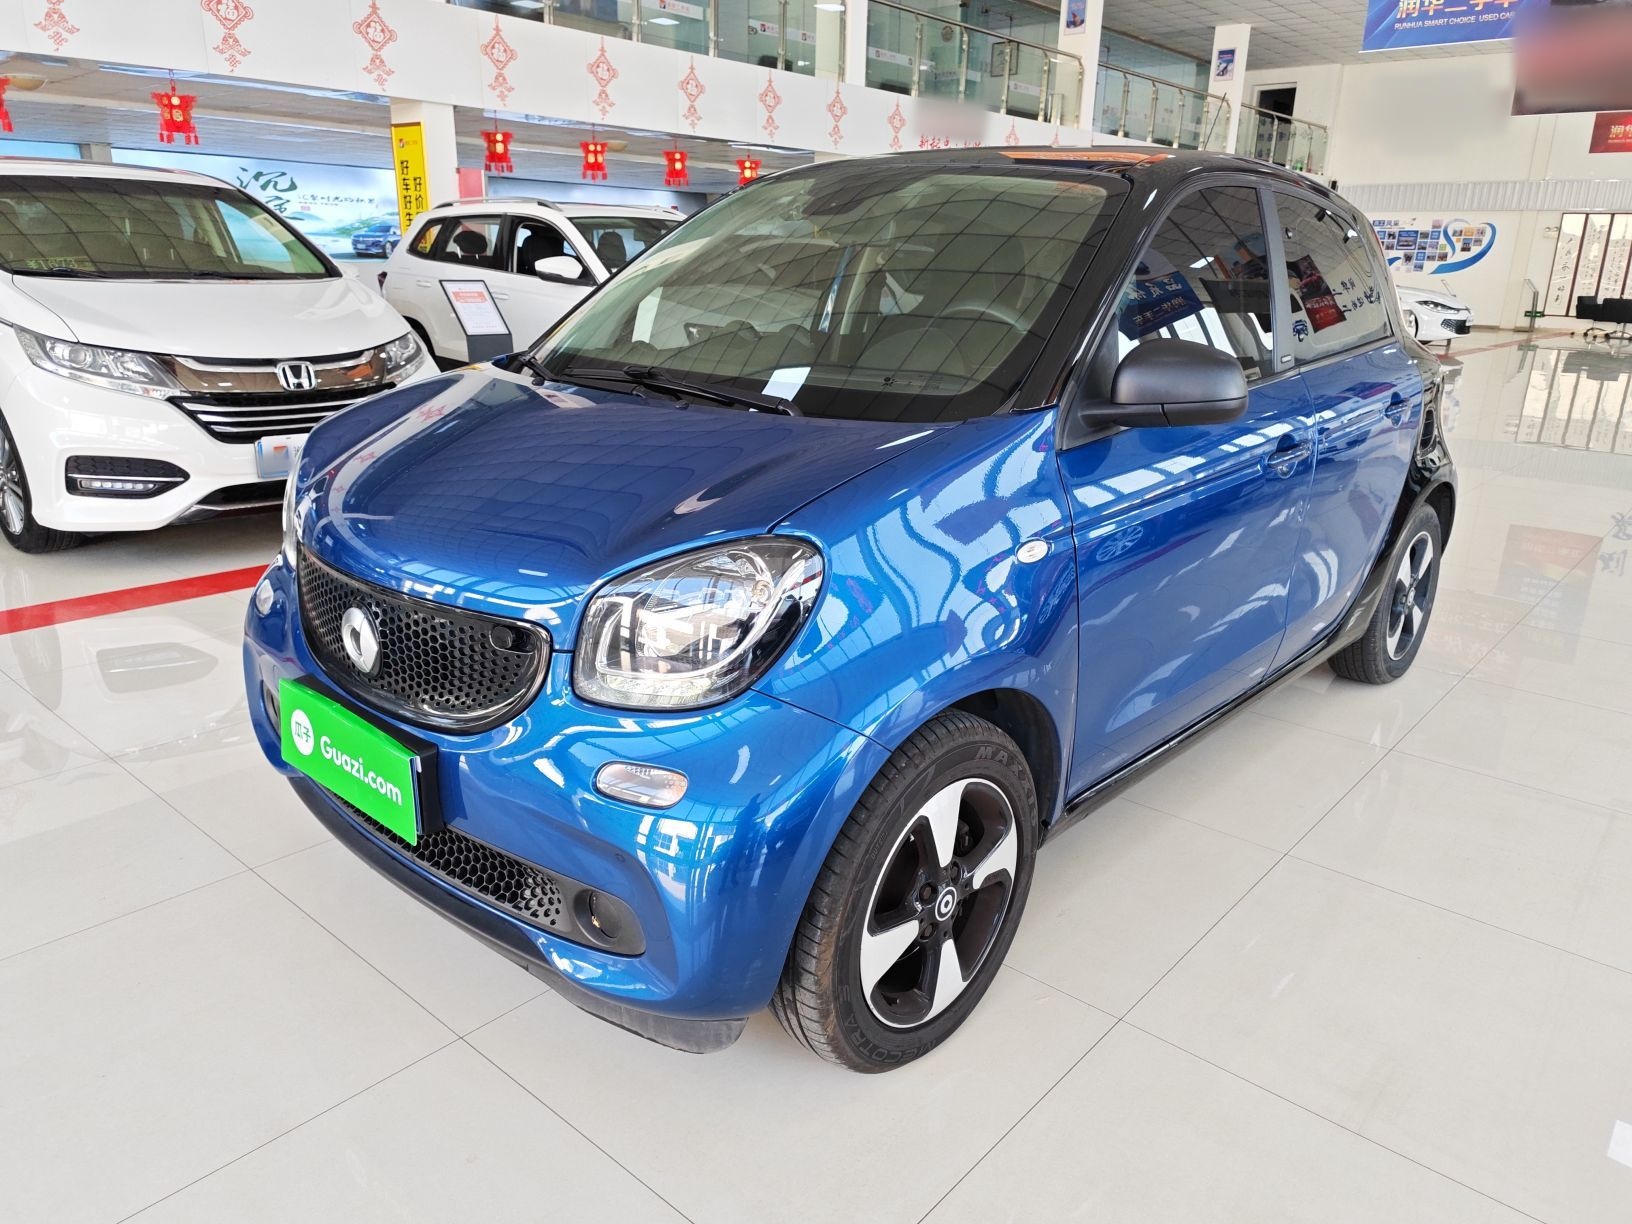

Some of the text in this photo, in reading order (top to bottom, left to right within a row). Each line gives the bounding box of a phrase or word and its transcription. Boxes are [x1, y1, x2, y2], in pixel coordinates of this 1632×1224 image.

[1394, 20, 1423, 30] RUNHUA
[1424, 18, 1448, 27] SMART
[1449, 15, 1476, 25] CHOICE
[1479, 13, 1499, 22] USED
[294, 721, 312, 743] 瓜子
[320, 735, 403, 806] Guazi.com
